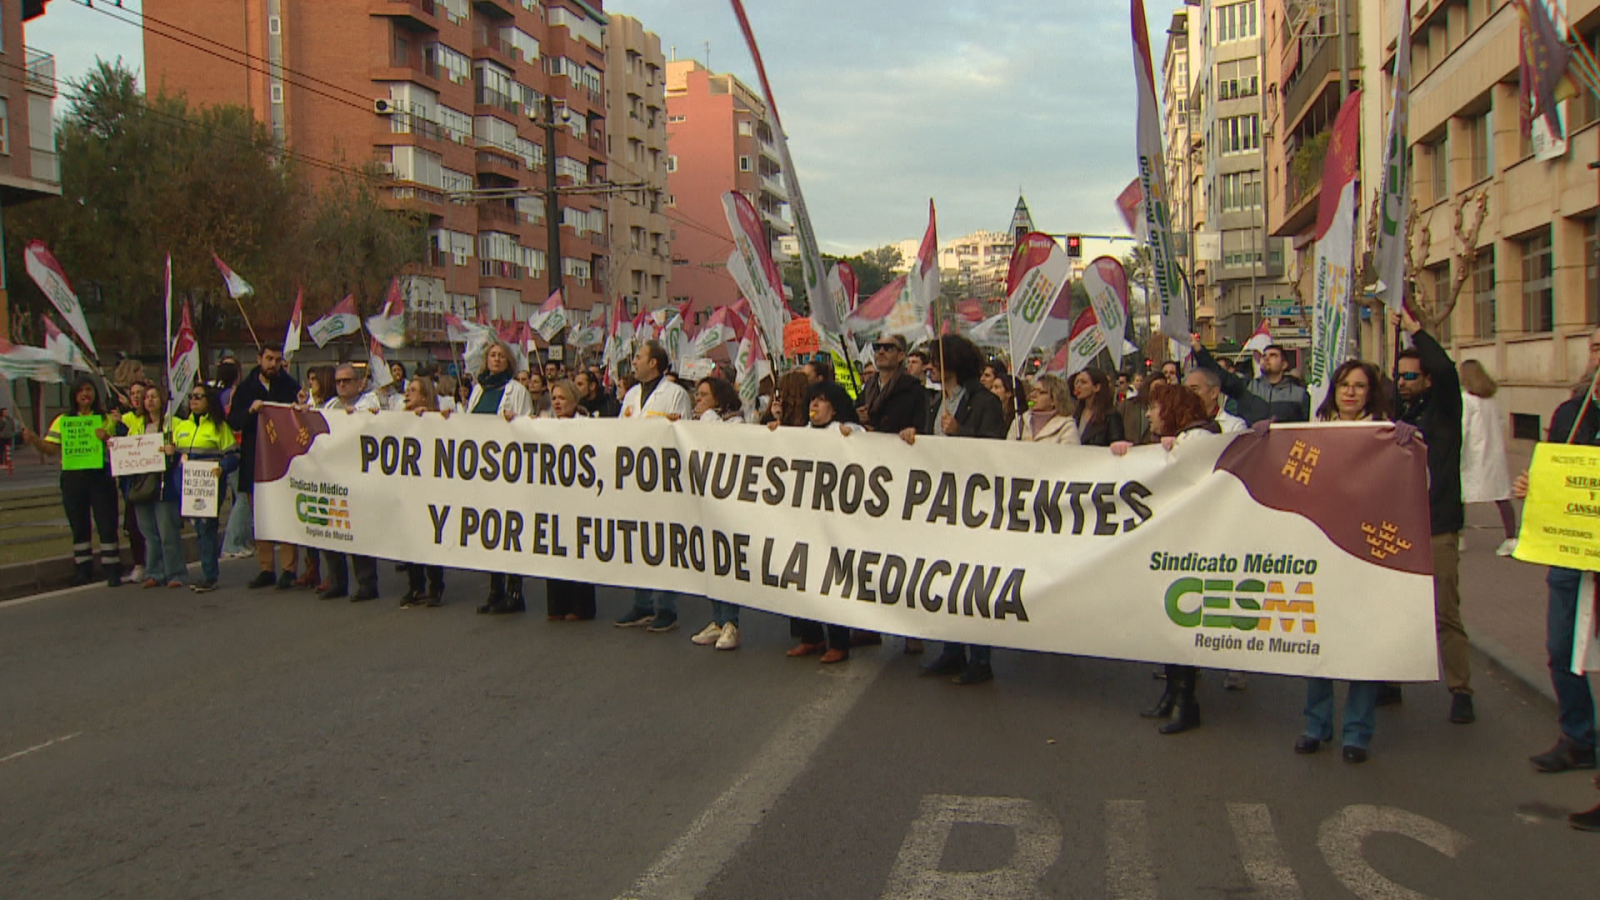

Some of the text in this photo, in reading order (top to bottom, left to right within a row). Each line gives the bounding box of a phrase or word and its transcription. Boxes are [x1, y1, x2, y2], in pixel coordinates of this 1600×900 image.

[289, 476, 349, 497] Sindicato Médico
[360, 434, 1154, 536] POR NOSOTROS, POR NUESTROS PACIENTES
[295, 492, 351, 530] CESM
[305, 525, 354, 542] Región de Murcia
[427, 504, 1030, 622] Y POR EL FUTURO DE LA MEDICINA
[1149, 551, 1318, 575] Sindicato Médico
[1164, 576, 1318, 635] CESM
[1195, 632, 1321, 656] Región de Murcia
